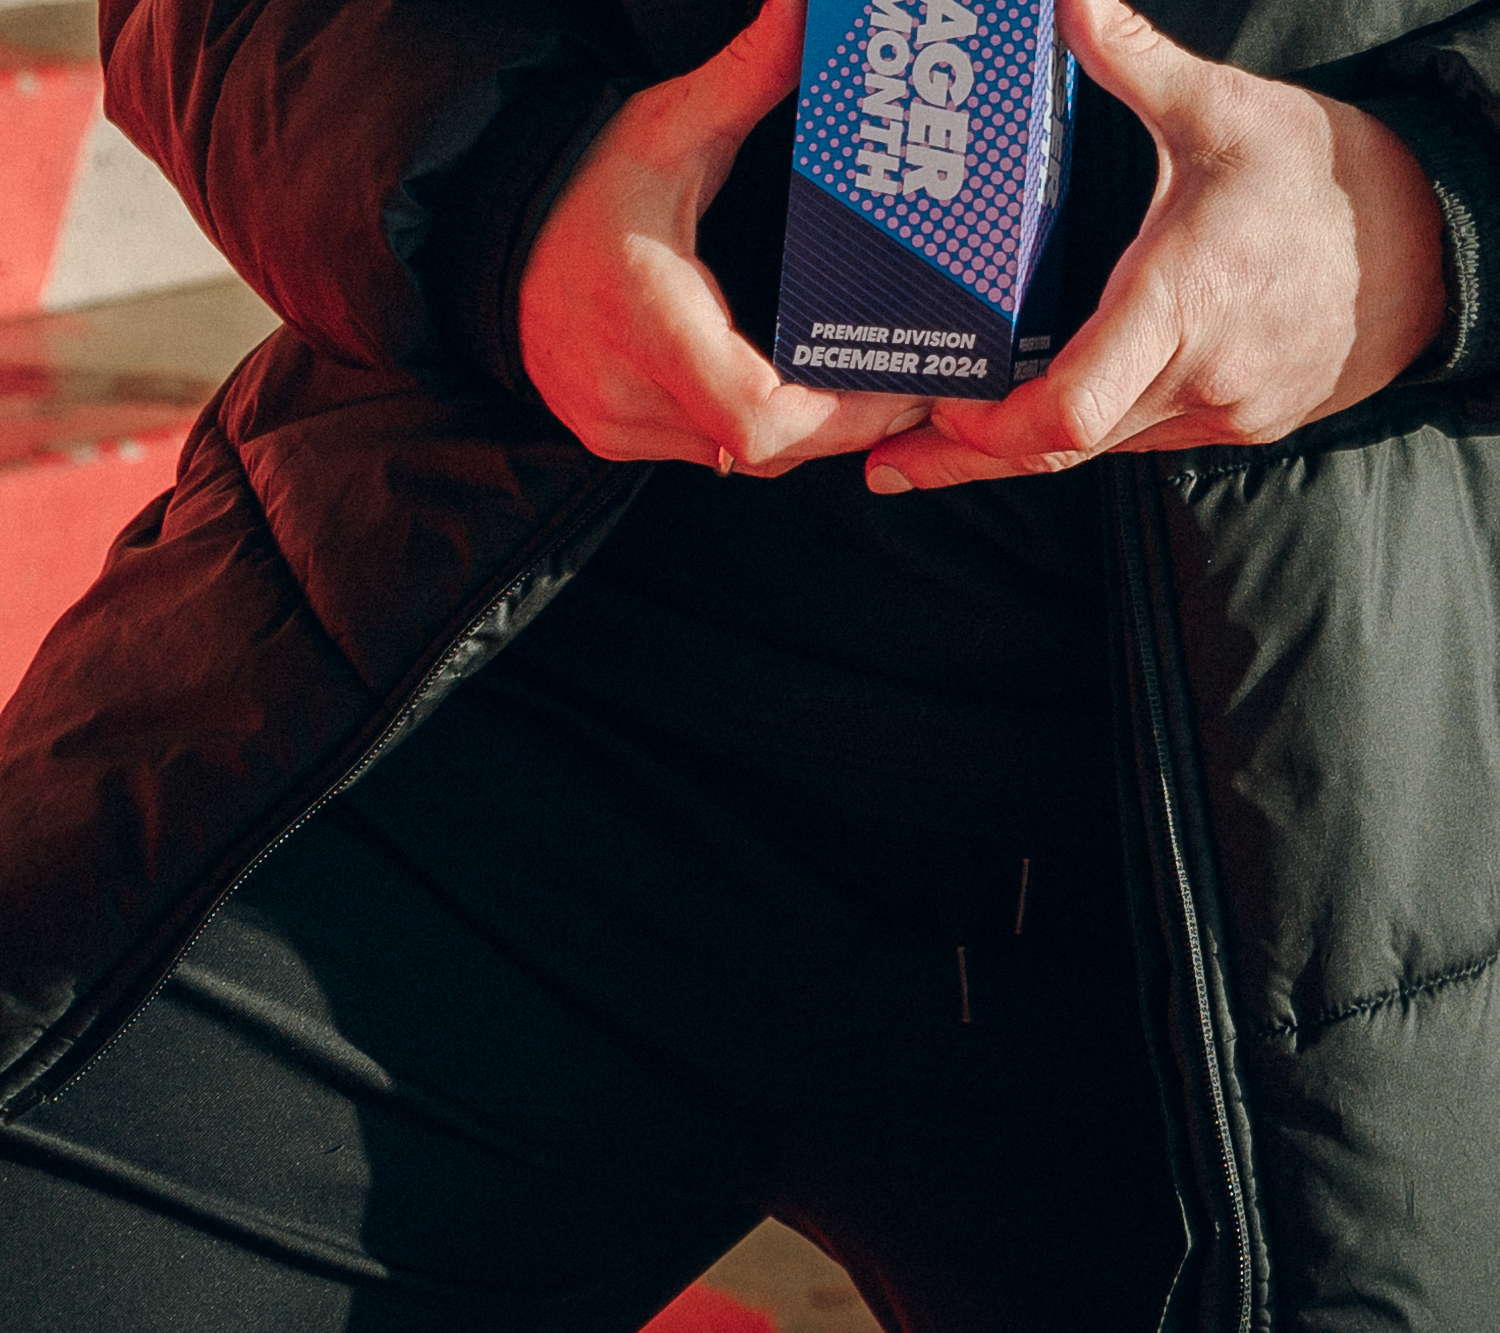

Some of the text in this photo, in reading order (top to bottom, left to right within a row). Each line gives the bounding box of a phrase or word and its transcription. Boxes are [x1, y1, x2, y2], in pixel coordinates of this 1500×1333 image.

[811, 321, 977, 350] PREMIER DIVISION
[792, 344, 920, 375] DECEMBER
[922, 354, 988, 379] 2024
